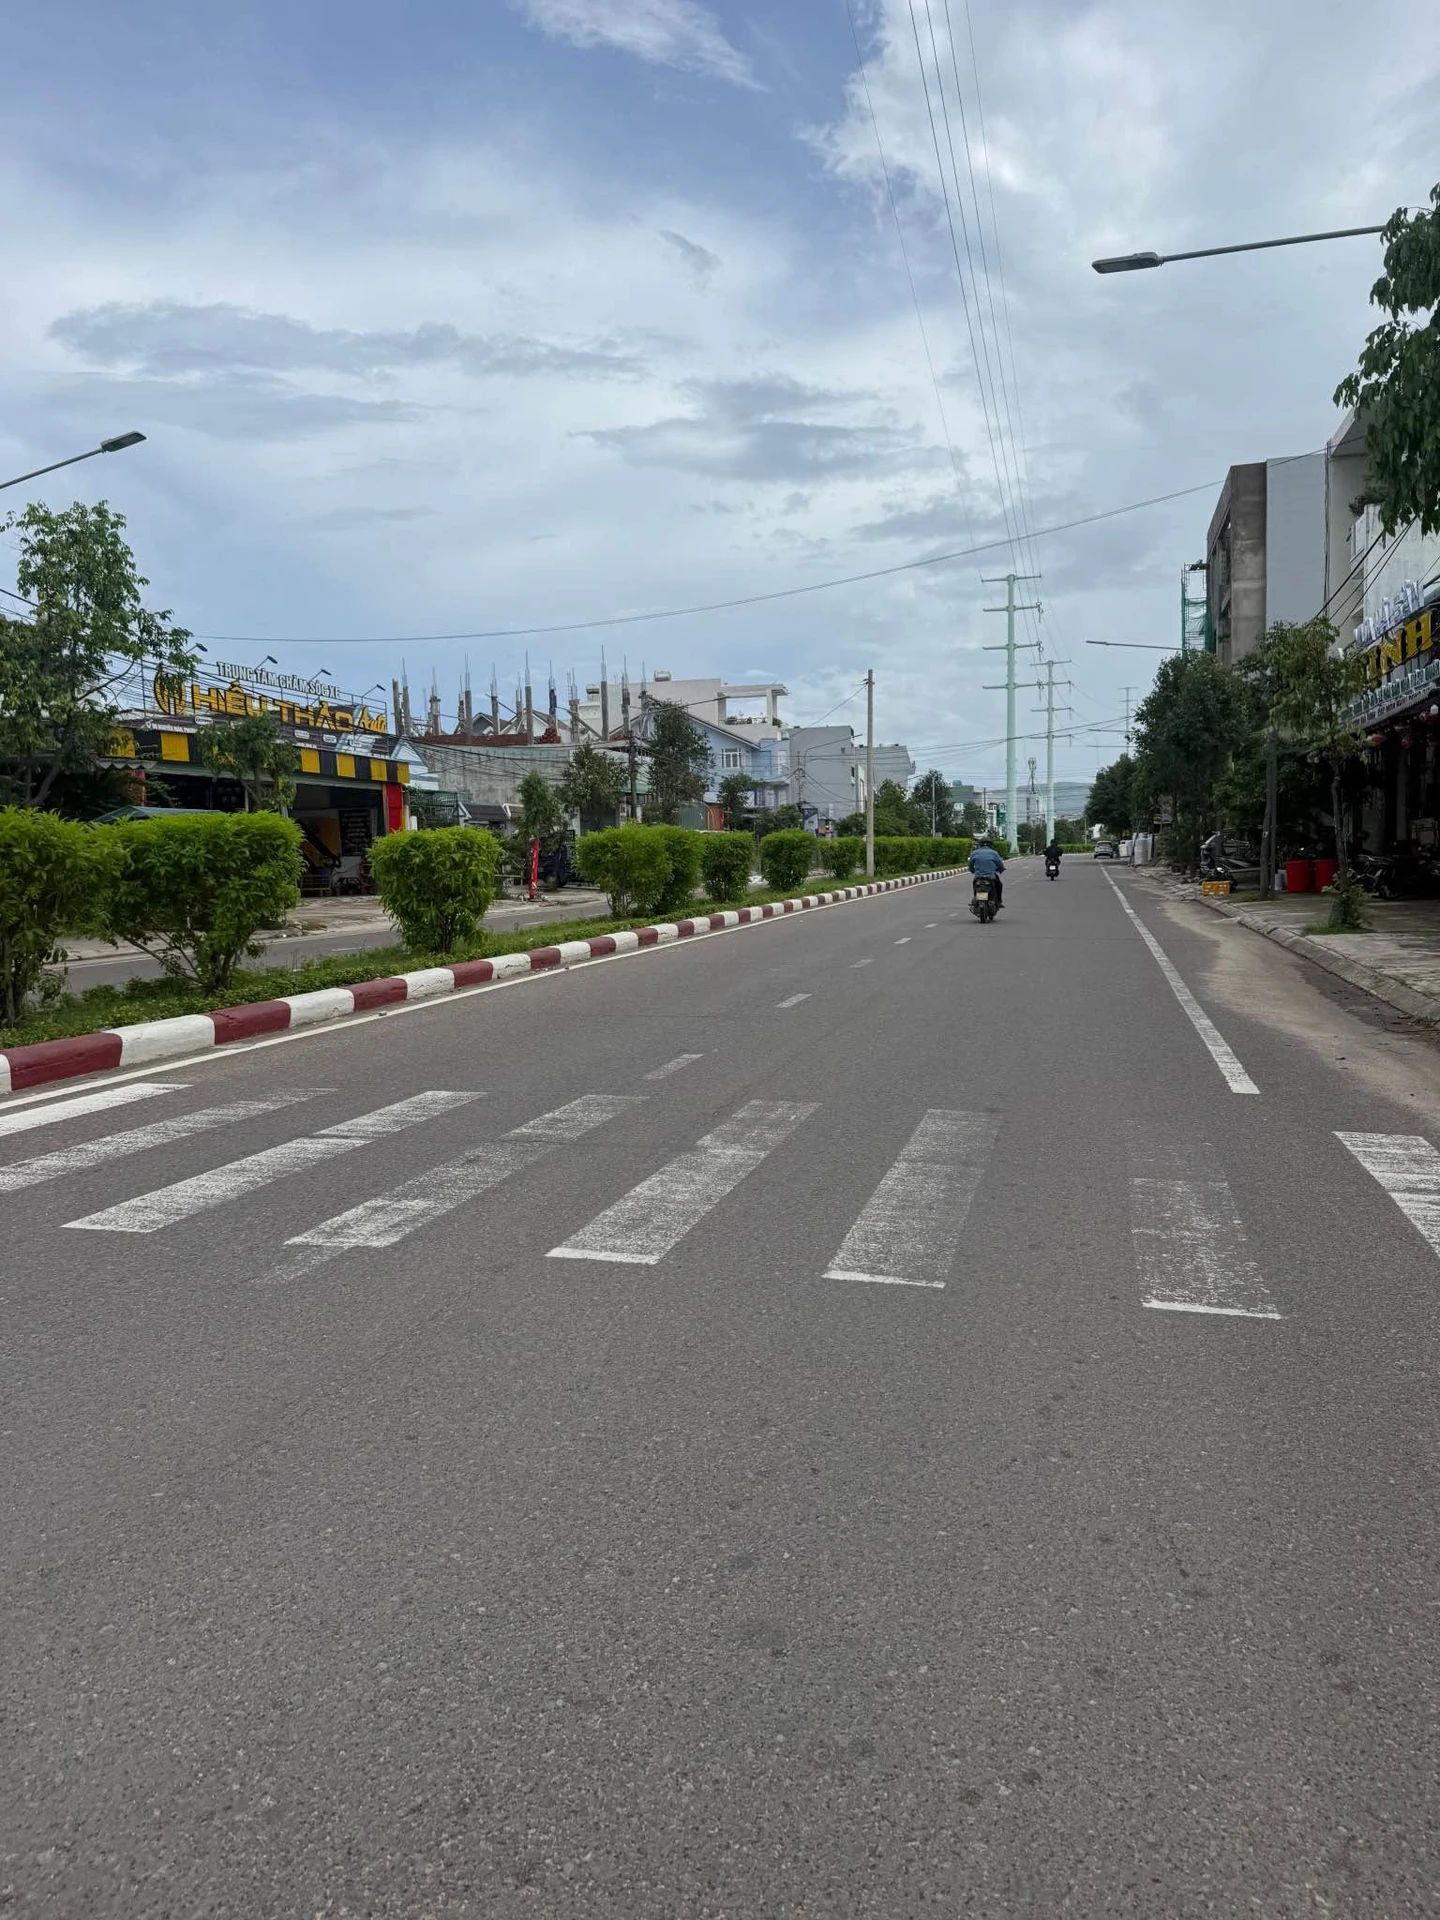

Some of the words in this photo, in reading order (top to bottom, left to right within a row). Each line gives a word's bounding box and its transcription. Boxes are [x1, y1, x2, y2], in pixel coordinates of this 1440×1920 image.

[216, 661, 254, 681] TRUNG
[255, 668, 279, 686] TÂM
[279, 674, 309, 692] CHĂM
[309, 680, 328, 698] SÓC
[328, 685, 340, 698] XE
